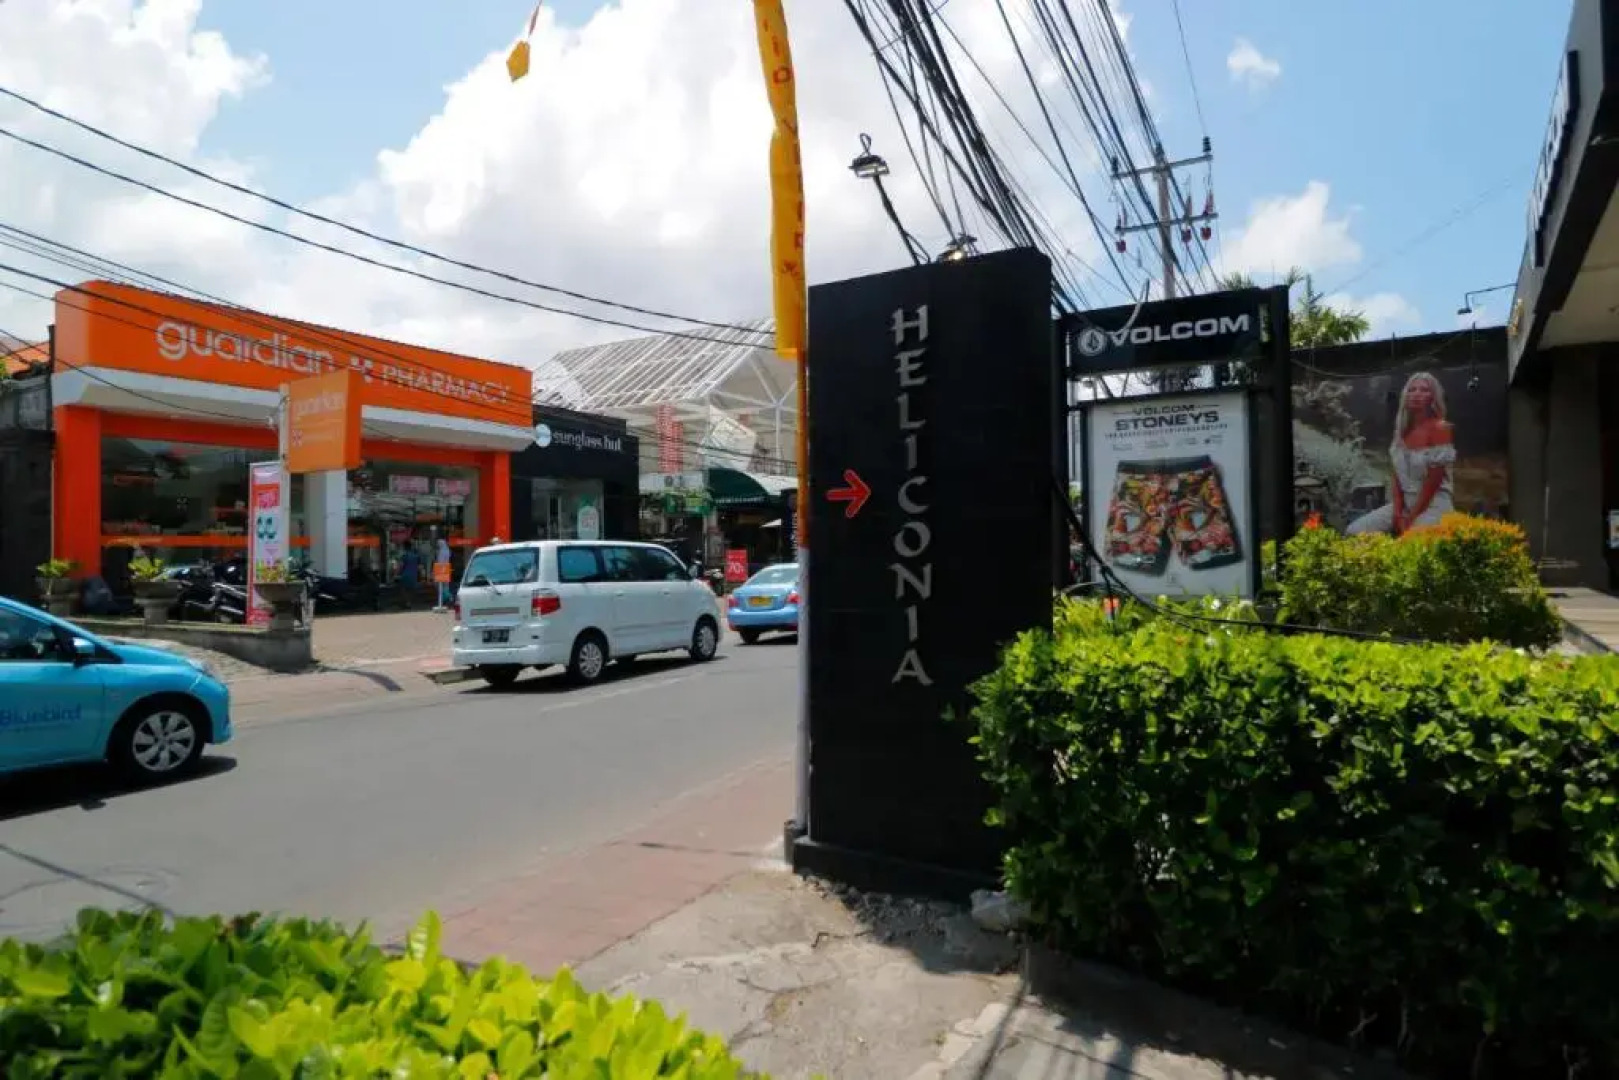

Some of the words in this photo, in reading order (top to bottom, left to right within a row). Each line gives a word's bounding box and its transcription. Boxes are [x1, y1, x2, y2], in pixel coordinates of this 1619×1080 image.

[156, 320, 336, 374] guardian
[1105, 313, 1250, 347] VOLCOM
[1115, 410, 1220, 431] STONEYS
[1132, 404, 1196, 416] VOLCOM
[890, 304, 935, 687] HELICONIA
